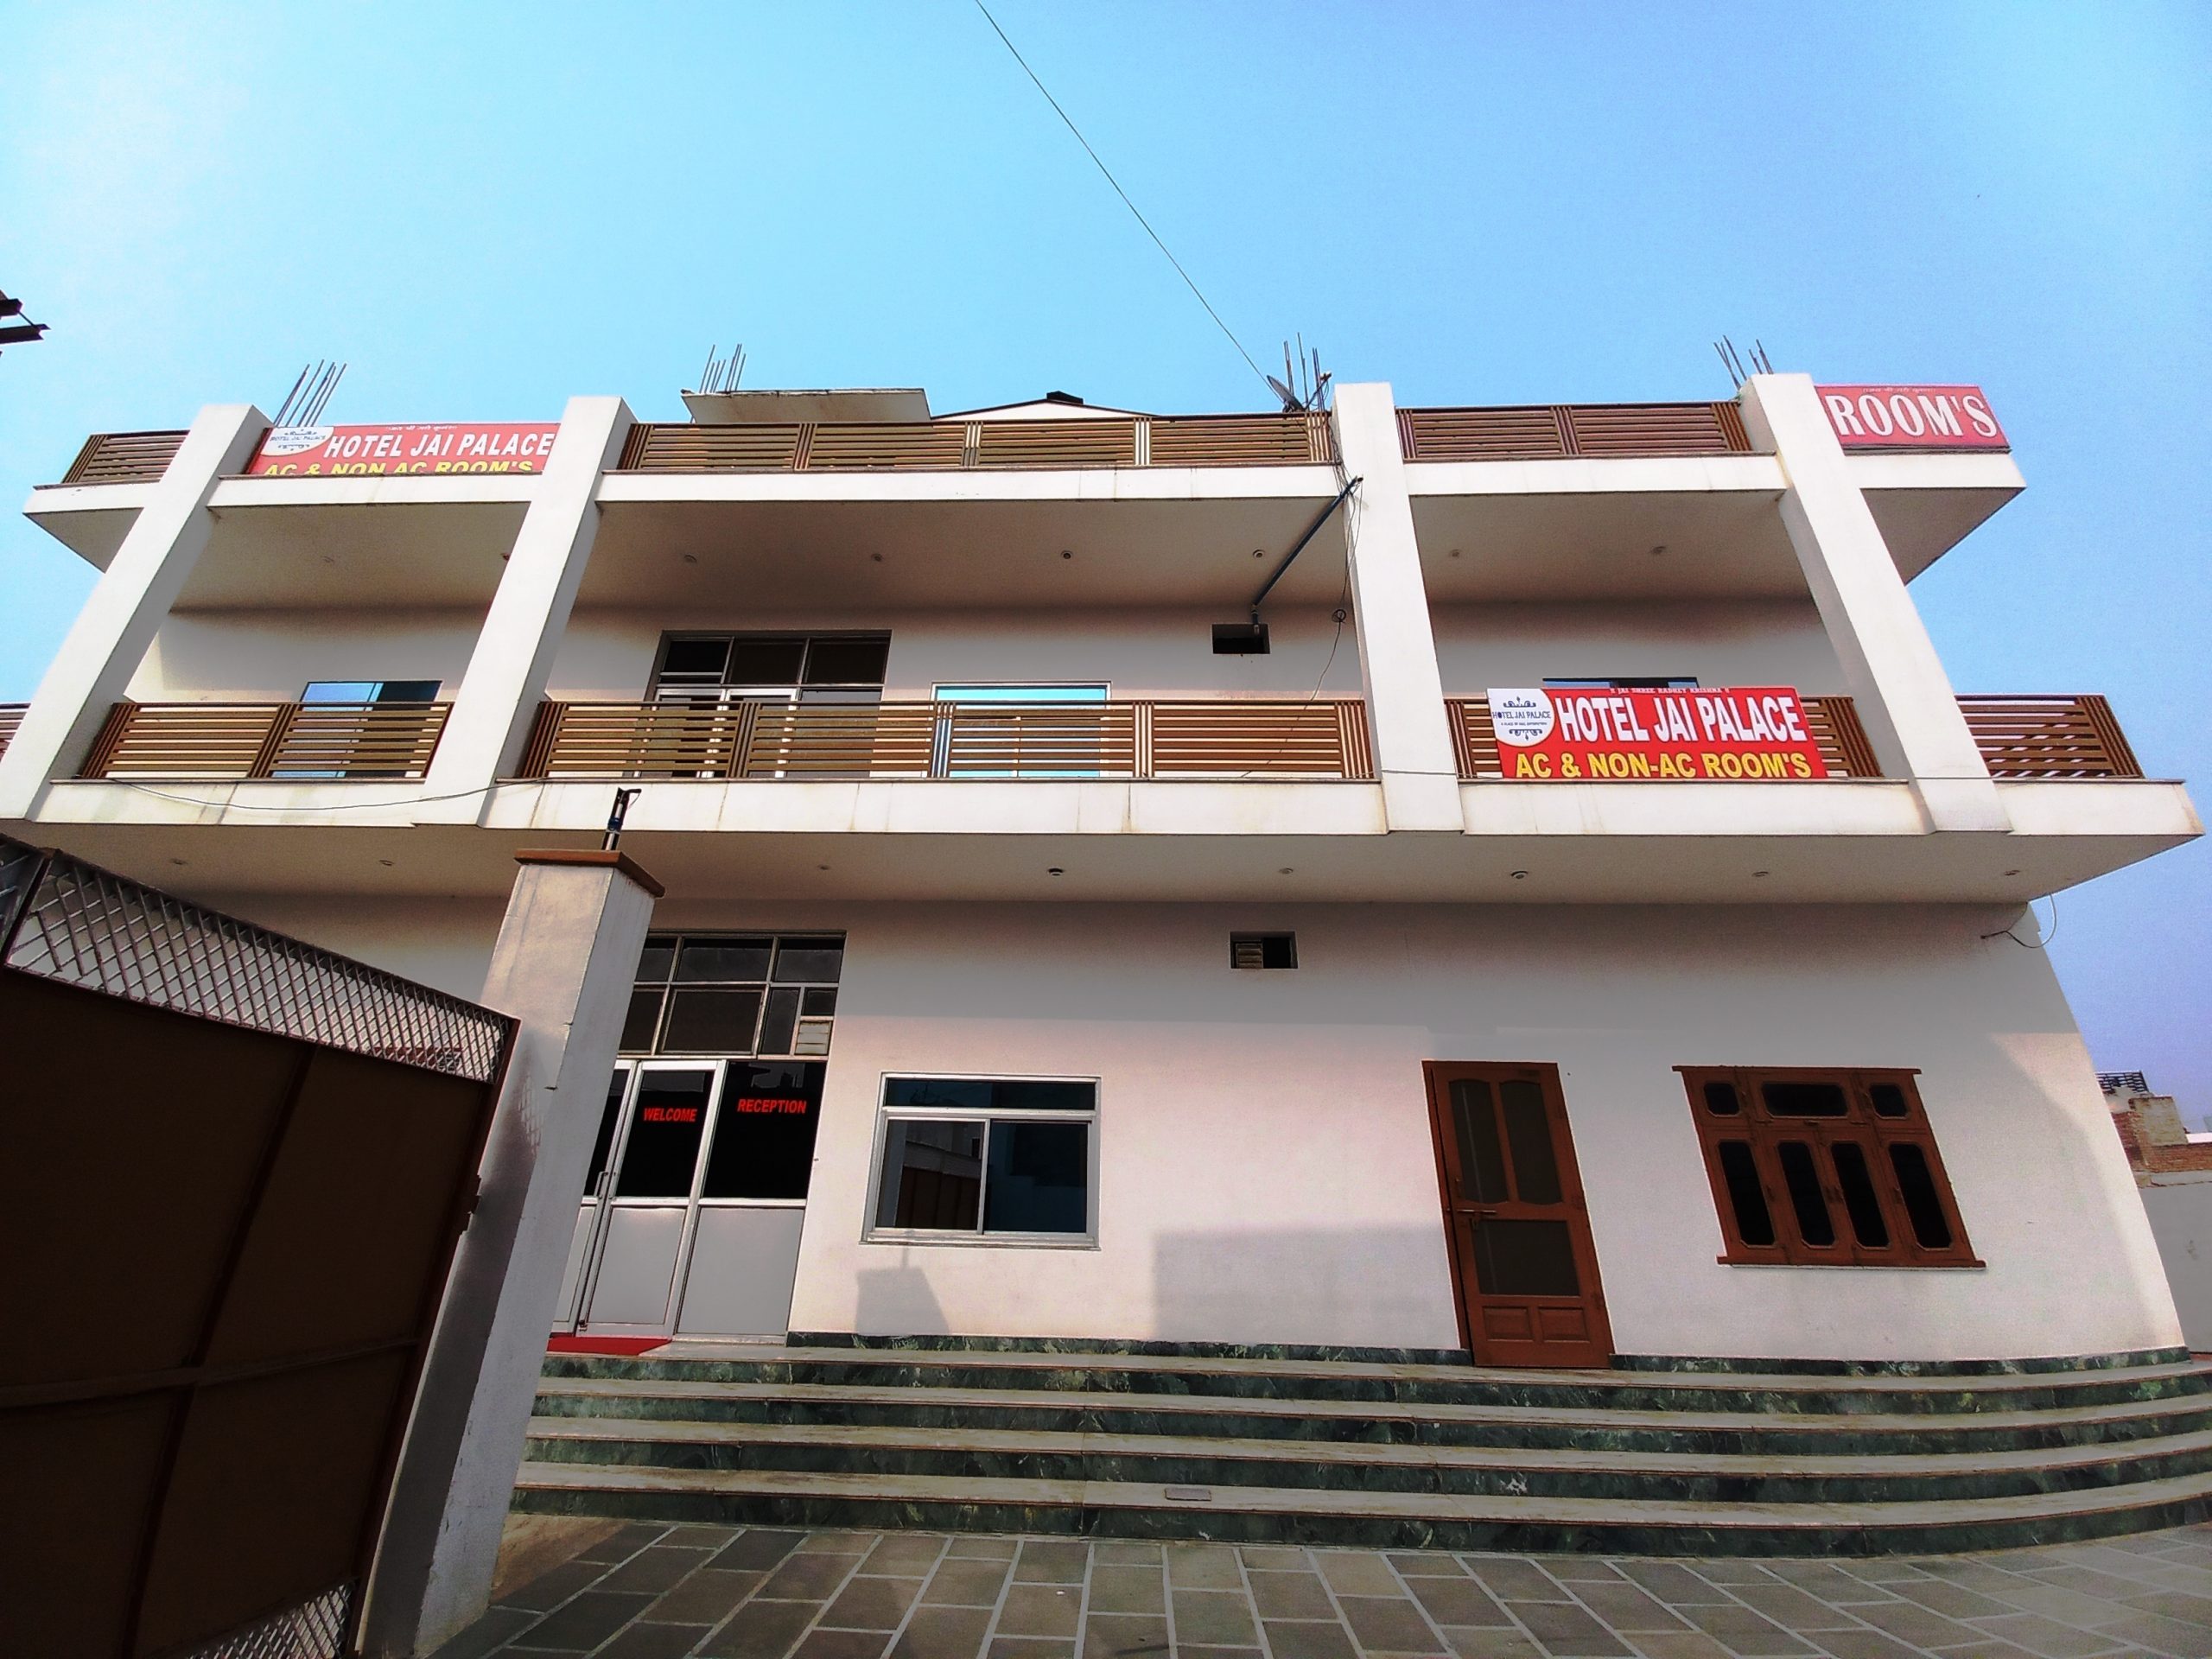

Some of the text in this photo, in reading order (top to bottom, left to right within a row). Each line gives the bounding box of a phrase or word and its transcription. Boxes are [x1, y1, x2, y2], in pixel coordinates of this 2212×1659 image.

[1825, 395, 1997, 437] ROOM'S
[323, 433, 555, 458] HOTEL JAI PALACE
[1554, 696, 1808, 741] HOTEL JAI PALACE
[1516, 753, 1812, 779] AC & NON-AC ROOM'S
[644, 1108, 697, 1122] WELCOME
[737, 1099, 807, 1114] RECEPTION
